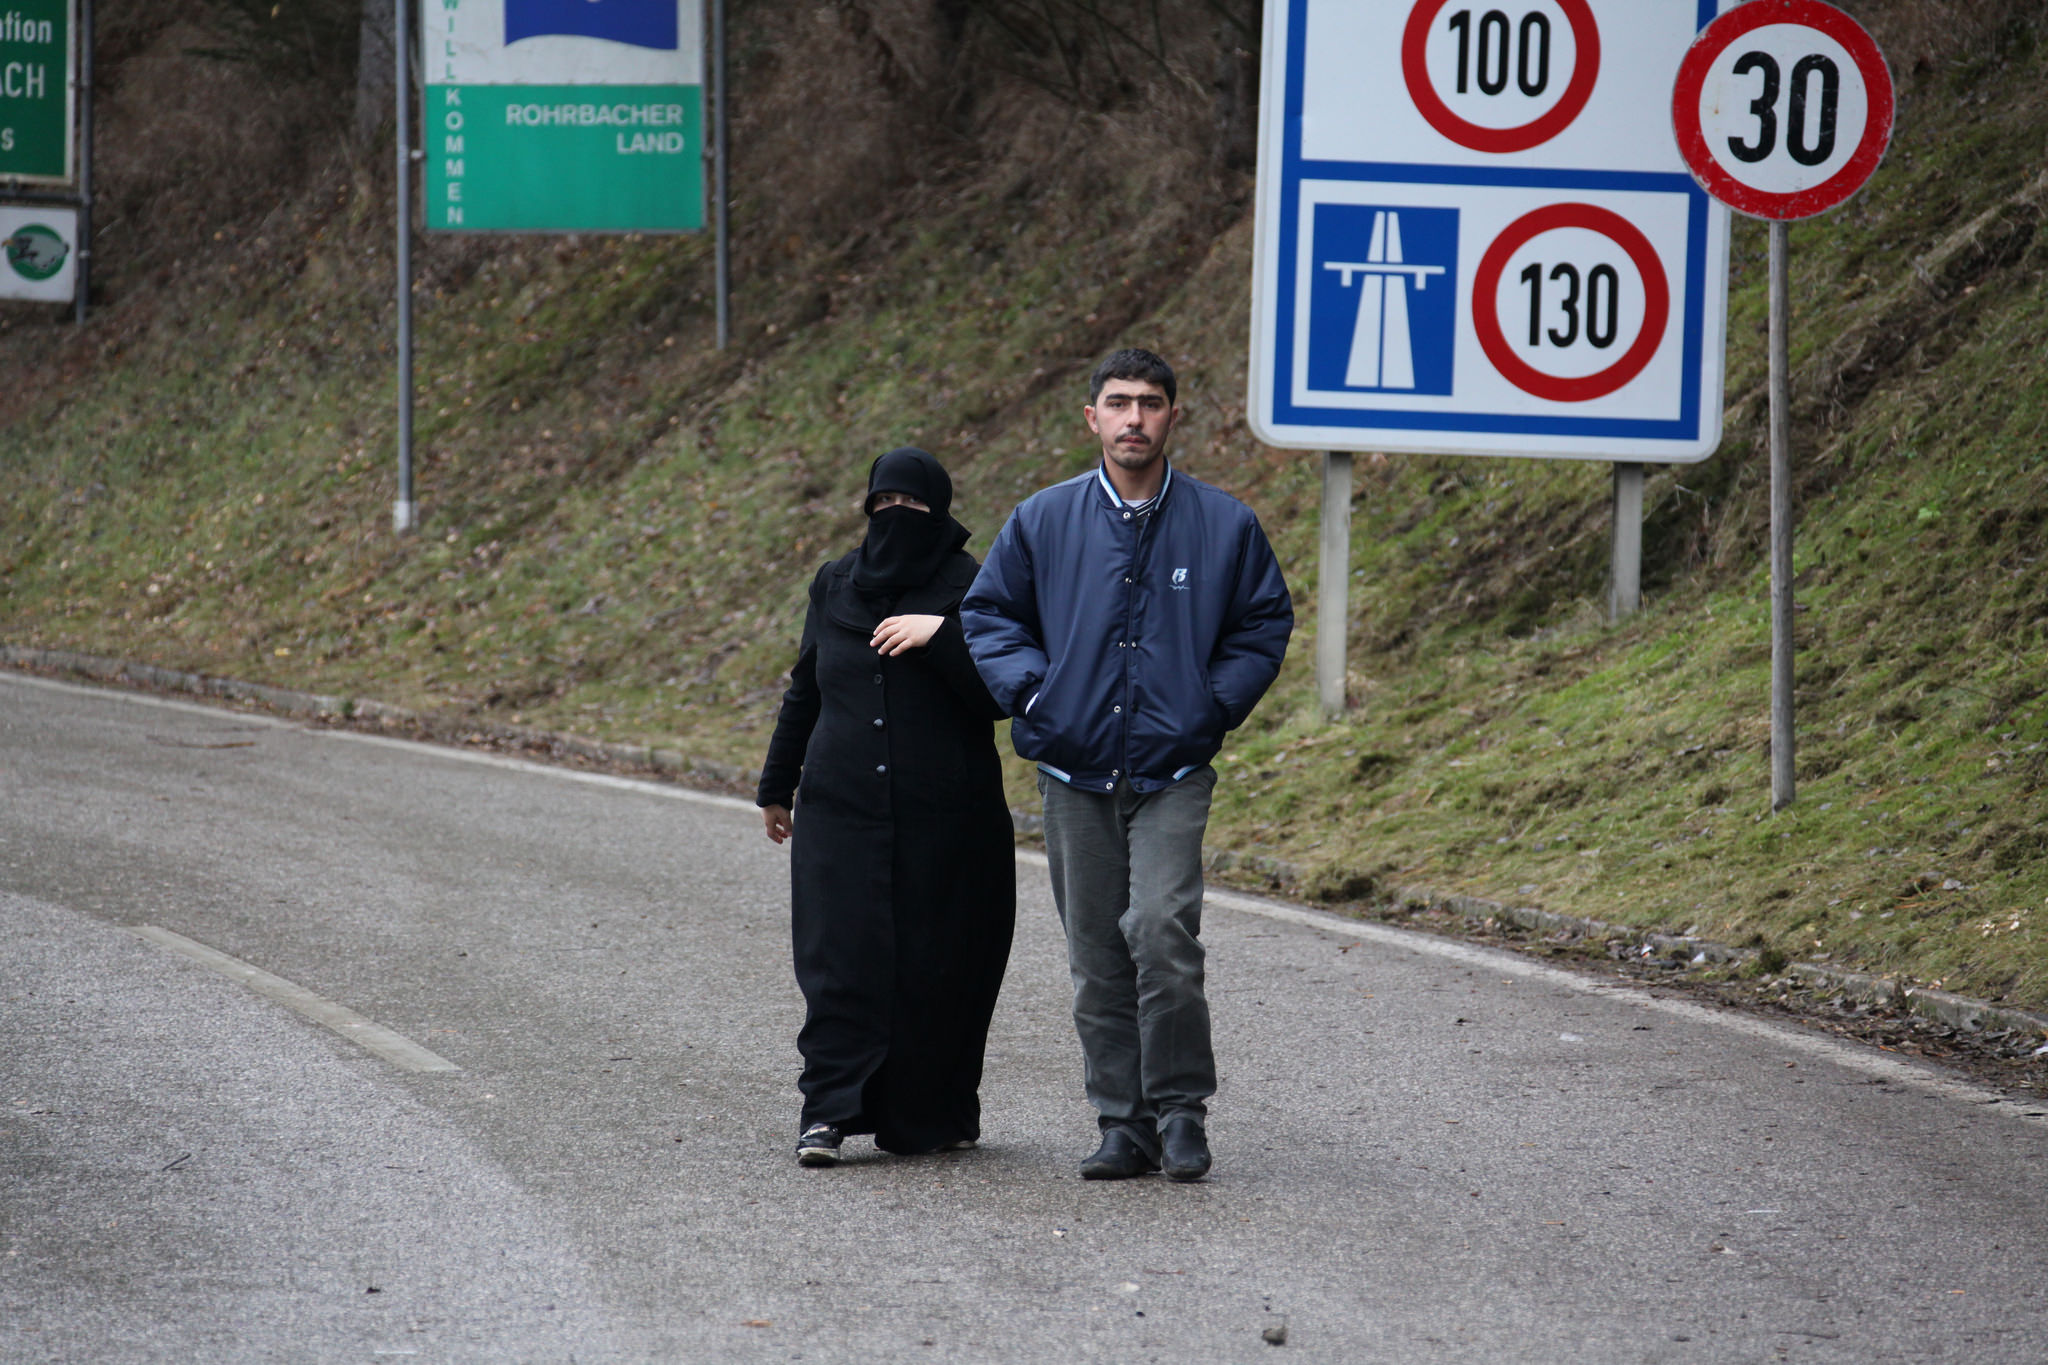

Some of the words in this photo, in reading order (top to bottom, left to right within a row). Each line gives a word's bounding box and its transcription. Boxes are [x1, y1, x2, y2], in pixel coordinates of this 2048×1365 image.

[1448, 9, 1551, 97] 100
[506, 104, 684, 126] ROHRBACHER
[617, 132, 684, 154] LAND
[1727, 50, 1841, 166] 30
[1520, 262, 1620, 349] 130
